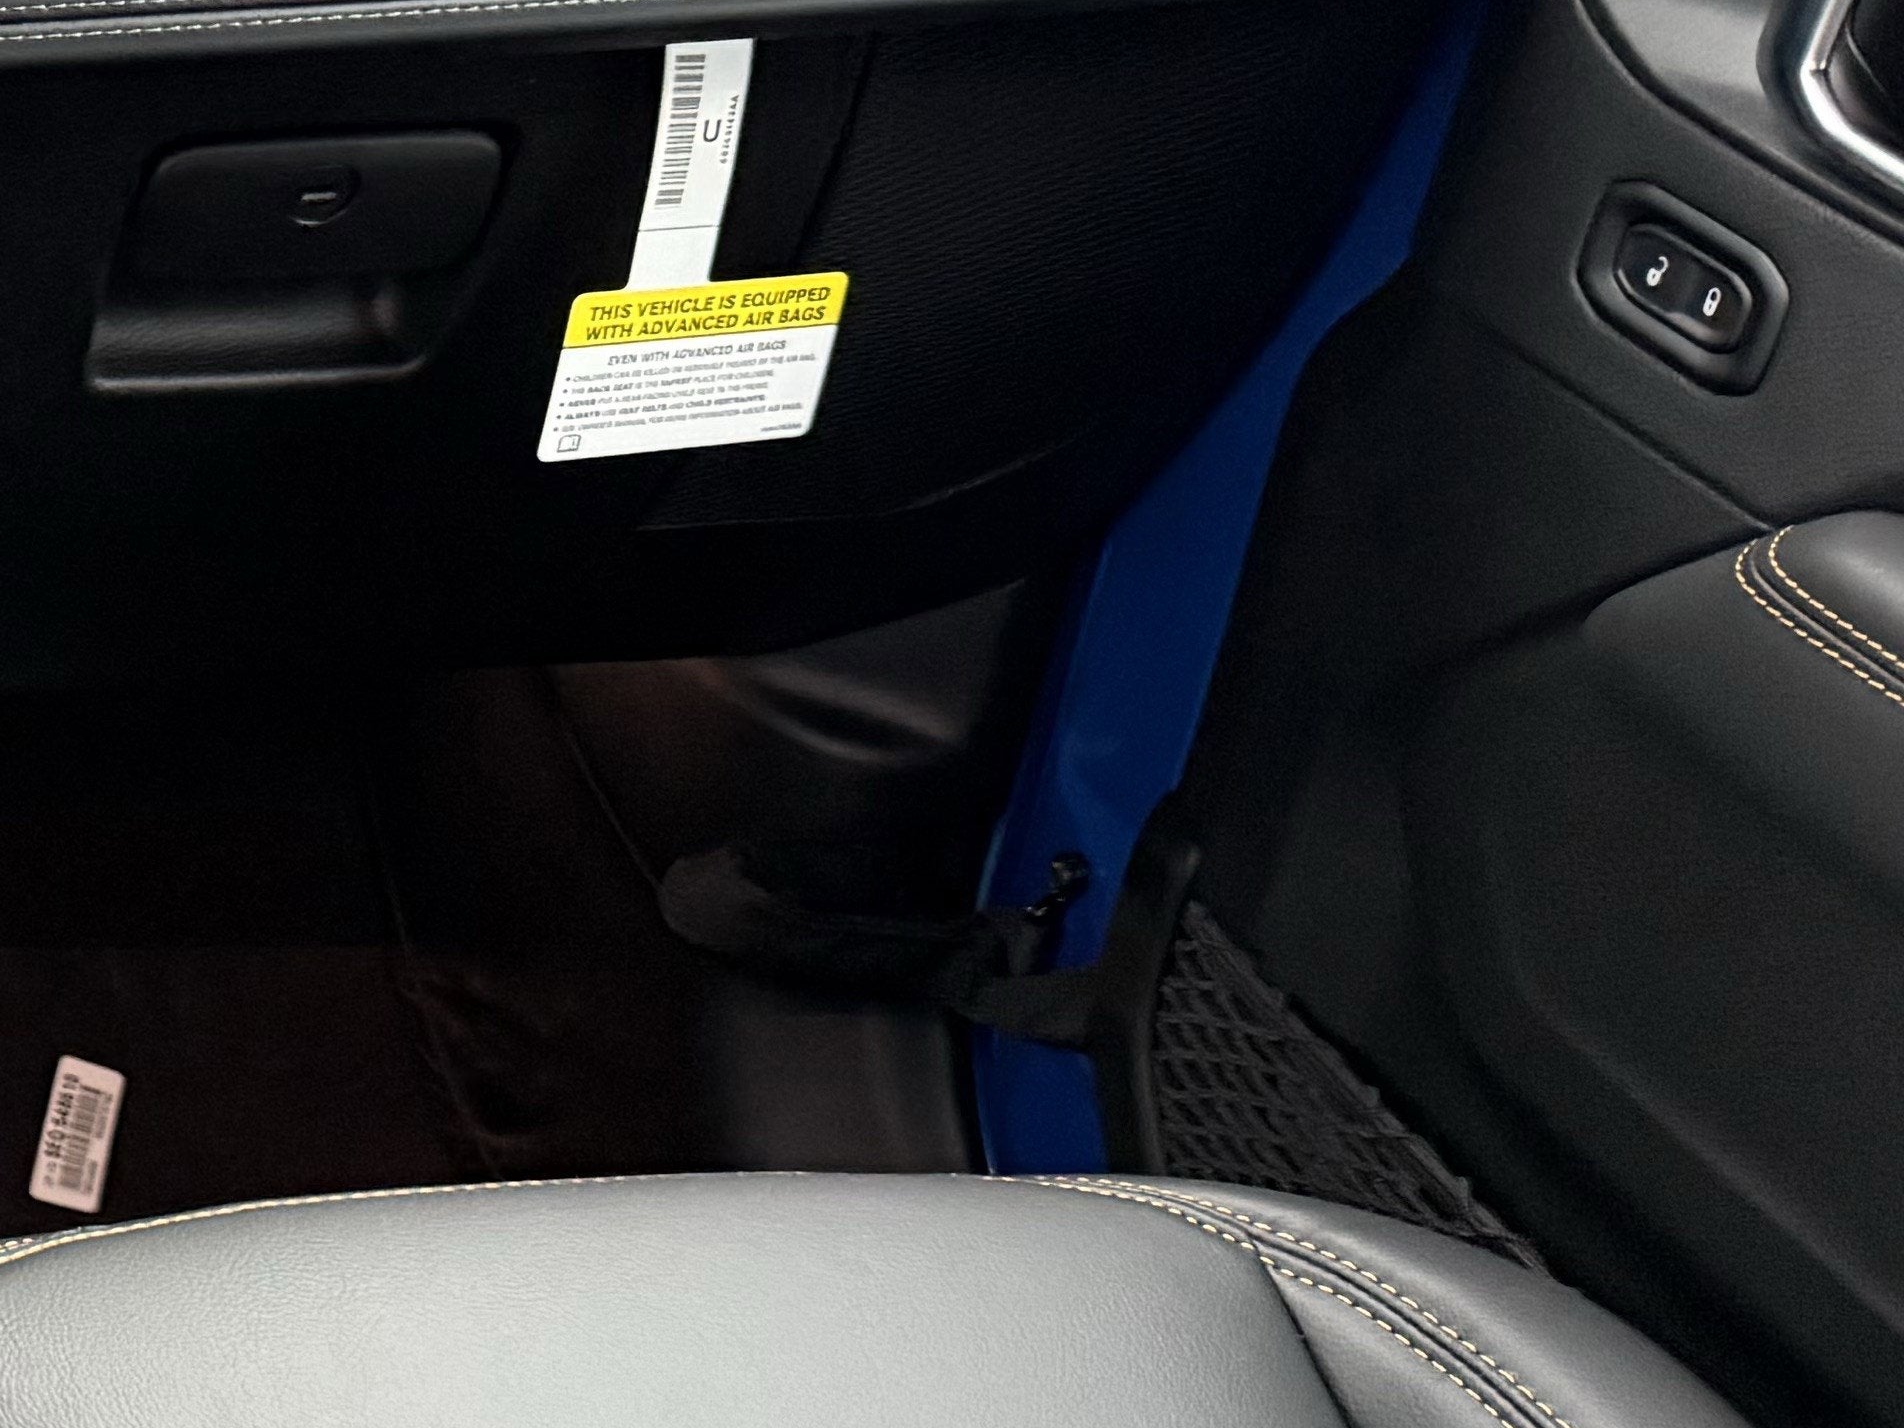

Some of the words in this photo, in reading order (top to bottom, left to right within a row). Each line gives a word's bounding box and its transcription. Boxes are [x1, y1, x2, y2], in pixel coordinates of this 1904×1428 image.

[703, 119, 722, 142] U
[589, 303, 633, 322] THIS
[637, 296, 716, 318] VEHICLE
[718, 294, 736, 310] IS
[740, 286, 831, 309] EQUIPPED
[585, 323, 633, 342] WITH
[637, 314, 740, 337] ADVANCED
[742, 311, 774, 326] AIR
[778, 305, 827, 323] BAGS
[641, 350, 670, 363] WITH
